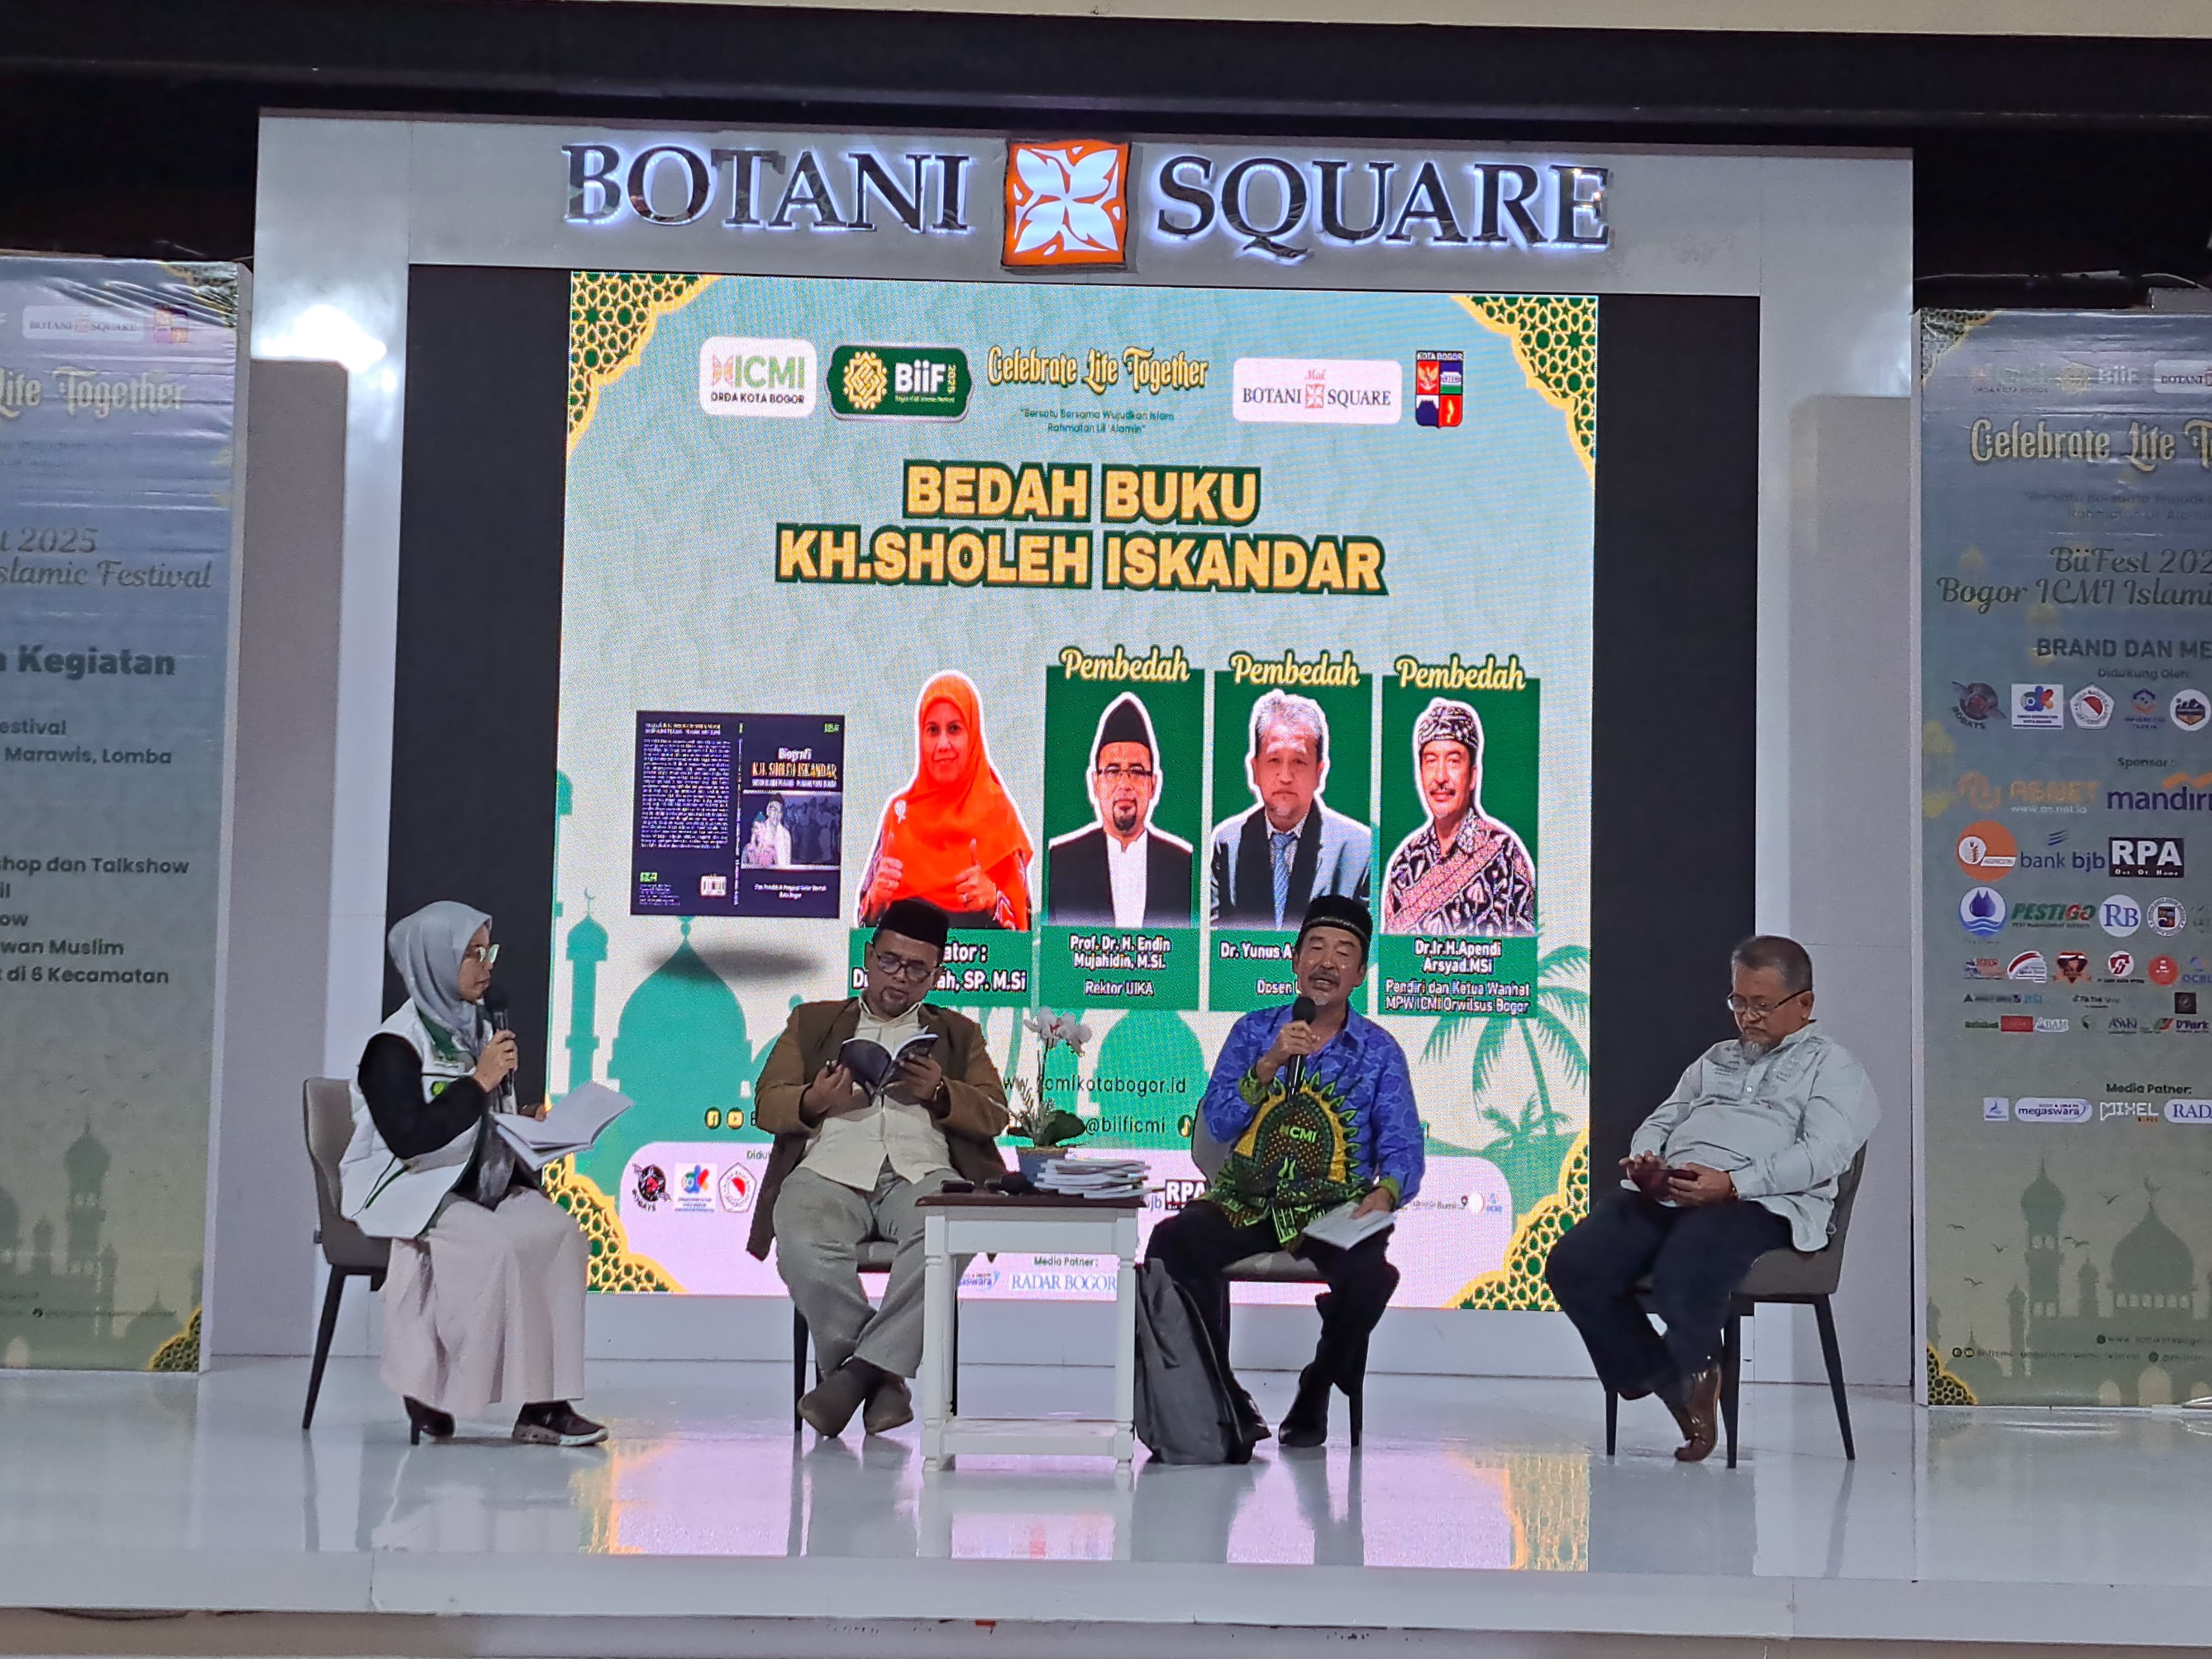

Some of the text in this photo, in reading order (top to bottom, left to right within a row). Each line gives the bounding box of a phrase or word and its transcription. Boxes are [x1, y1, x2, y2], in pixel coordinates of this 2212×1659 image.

[562, 145, 1611, 262] BOTANI SQUARE
[733, 355, 806, 390] ICMI
[895, 359, 946, 393] BiiF
[987, 346, 1077, 387] Celebrate
[1124, 347, 1209, 393] Together
[53, 366, 186, 420] Together
[711, 392, 805, 405] ORDA KOTA BOGOR
[1242, 387, 1392, 408] BOTANI SQUARE
[1971, 418, 2110, 464] Celebrate
[906, 465, 1258, 522] BEDAH BUKU
[17, 528, 99, 554] 2025
[778, 529, 1382, 591] KH.SHOLEH ISKANDAR
[97, 559, 213, 588] Festival
[1936, 576, 2029, 614] Bogor
[2035, 578, 2116, 605] ICMI
[2037, 638, 2117, 657] BRAND
[2125, 639, 2173, 659] DAN
[18, 644, 175, 680] Kegiatan
[1060, 646, 1190, 682] Pembedah
[1231, 651, 1361, 685] Pembedah
[1396, 655, 1526, 690] Pembedah
[4, 747, 172, 766] Marawis, Lomba
[2118, 757, 2168, 770] Sponsor
[2021, 852, 2066, 869] bank
[2072, 852, 2106, 873] bjb
[2111, 840, 2182, 866] RPA
[46, 857, 87, 873] dan
[91, 857, 189, 874] Talkshow
[2011, 903, 2097, 921] PESTIGO
[2104, 903, 2139, 927] RB
[49, 939, 124, 956] Muslim
[1070, 935, 1171, 952] Prof. Dr. H. Endin
[1220, 942, 1239, 958] Dr.
[1242, 942, 1280, 958] Yunus
[7, 966, 26, 982] di
[49, 967, 169, 984] Kecamatan
[964, 971, 989, 990] SP.
[992, 971, 1027, 990] M.Si
[1085, 980, 1154, 996] Rektor UIKA
[1428, 980, 1449, 994] dan
[2106, 1083, 2144, 1094] Media
[2018, 1107, 2080, 1118] megaswara
[1011, 1276, 1117, 1292] RADAR BOGOR
